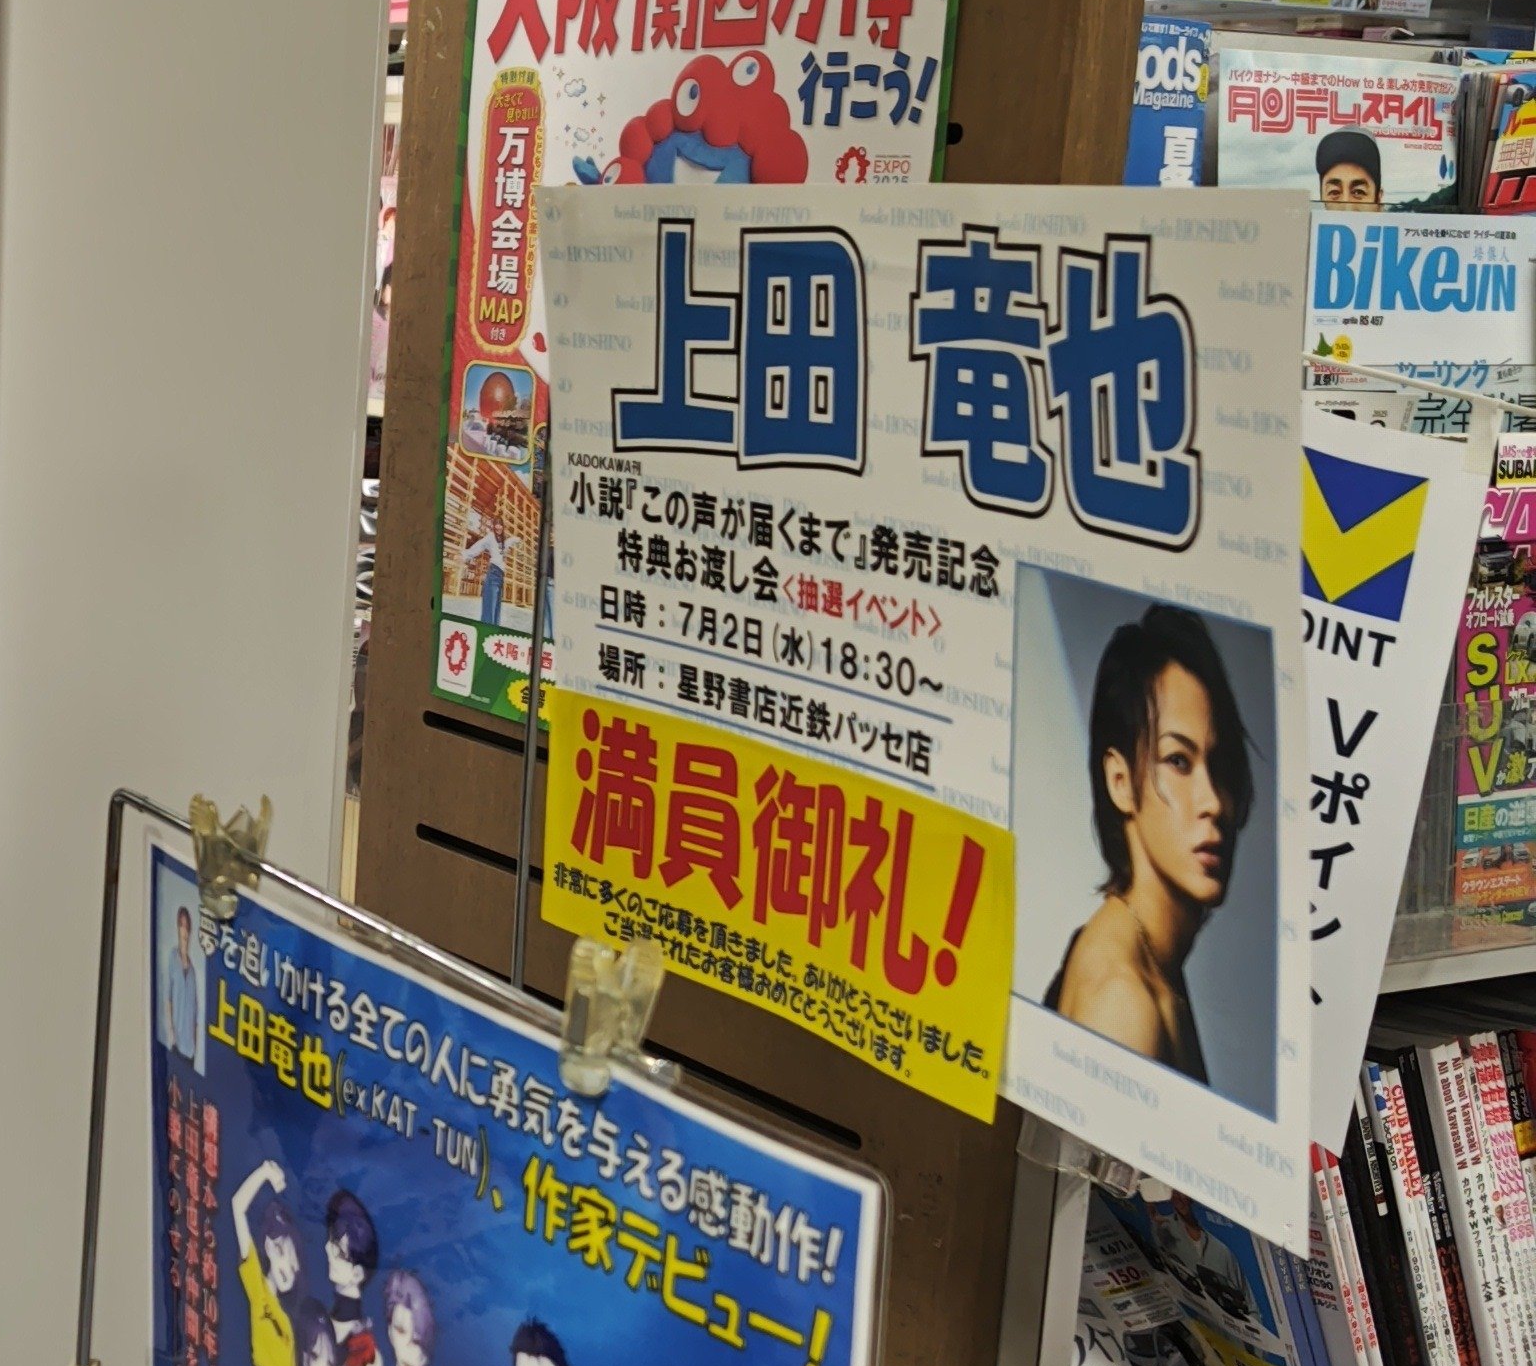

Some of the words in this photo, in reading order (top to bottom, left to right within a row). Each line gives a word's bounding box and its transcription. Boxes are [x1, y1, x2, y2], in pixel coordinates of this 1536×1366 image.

[798, 49, 939, 128] 行こう!
[873, 160, 911, 175] EXPO
[486, 126, 530, 296] 万博会場
[1313, 223, 1516, 313] BikeJIN
[478, 296, 524, 326] MAP
[610, 219, 867, 477] 上田
[908, 222, 1201, 553] 竜也
[1395, 358, 1490, 389] ツーリング
[568, 453, 642, 476] KADOKAWA刊
[569, 472, 1001, 600] 小説『この声が届くまで』発売記念
[1467, 586, 1521, 612] フォレスター
[1464, 632, 1505, 798] SUV
[570, 707, 986, 996] 満員御礼!
[1309, 697, 1378, 1005] Vポイン
[1440, 1075, 1456, 1108] about
[1454, 1071, 1470, 1104] about
[1392, 1084, 1410, 1134] CLUB
[1403, 1131, 1426, 1198] HARLEY
[1445, 1106, 1466, 1159] Kawasaki
[1460, 1101, 1481, 1156] Kawasaki
